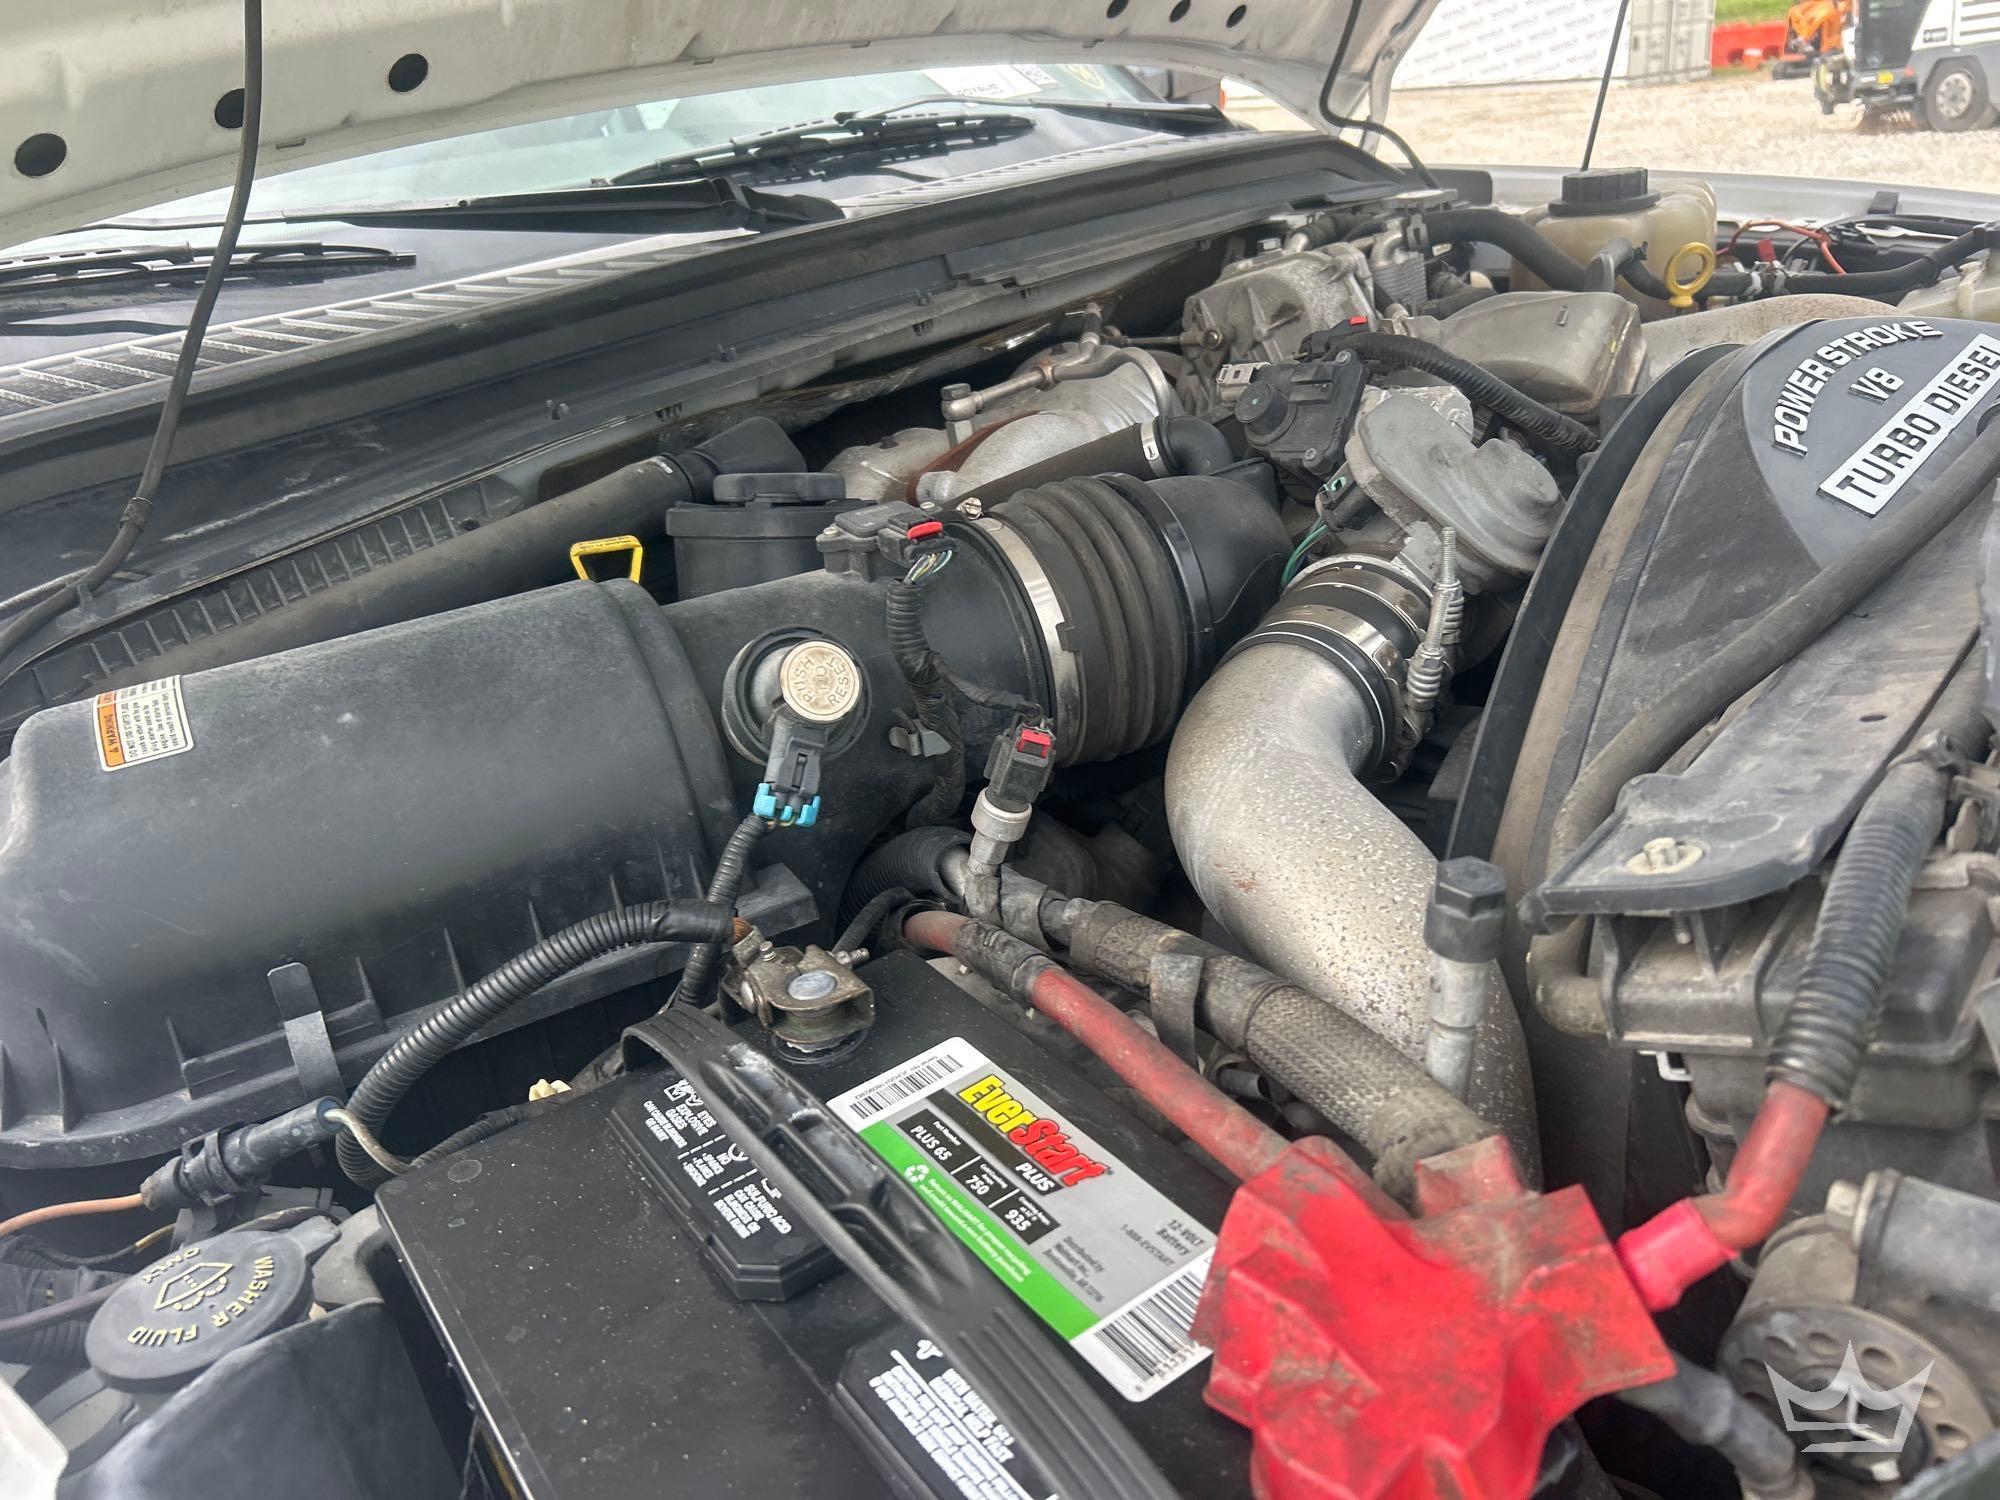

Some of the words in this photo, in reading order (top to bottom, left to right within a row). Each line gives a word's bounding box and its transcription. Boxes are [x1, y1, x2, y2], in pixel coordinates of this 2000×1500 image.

[1774, 358, 1835, 454] POWER
[1816, 320, 1943, 367] STROKE
[1850, 367, 1904, 402] V8
[1835, 412, 1941, 499] TURBO
[794, 656, 815, 703] PUSH
[826, 656, 849, 706] RESET
[104, 715, 118, 745] WARNING
[665, 1108, 688, 1130] GASES
[675, 1103, 709, 1136] EXPLOSIVE
[696, 1110, 717, 1129] EYES
[957, 1073, 1111, 1188] EverStart
[910, 1125, 940, 1149] PLUS
[934, 1146, 952, 1161] 65
[942, 1128, 961, 1146] Number
[716, 1152, 732, 1166] NO
[965, 1174, 990, 1195] 750
[1015, 1162, 1055, 1192] PLUS
[734, 1189, 750, 1204] CAN
[743, 1200, 765, 1222] CAUSE
[743, 1184, 778, 1219] SULFURIC
[770, 1215, 792, 1234] ACID
[1004, 1209, 1031, 1231] 935
[747, 1221, 761, 1234] OR
[1156, 1227, 1192, 1257] Battery
[1167, 1219, 1205, 1247] 12-VOLT
[143, 1248, 200, 1284] ONLY
[210, 1255, 274, 1328] WASHER
[127, 1324, 198, 1346] FLUID
[983, 1434, 1015, 1463] FAST
